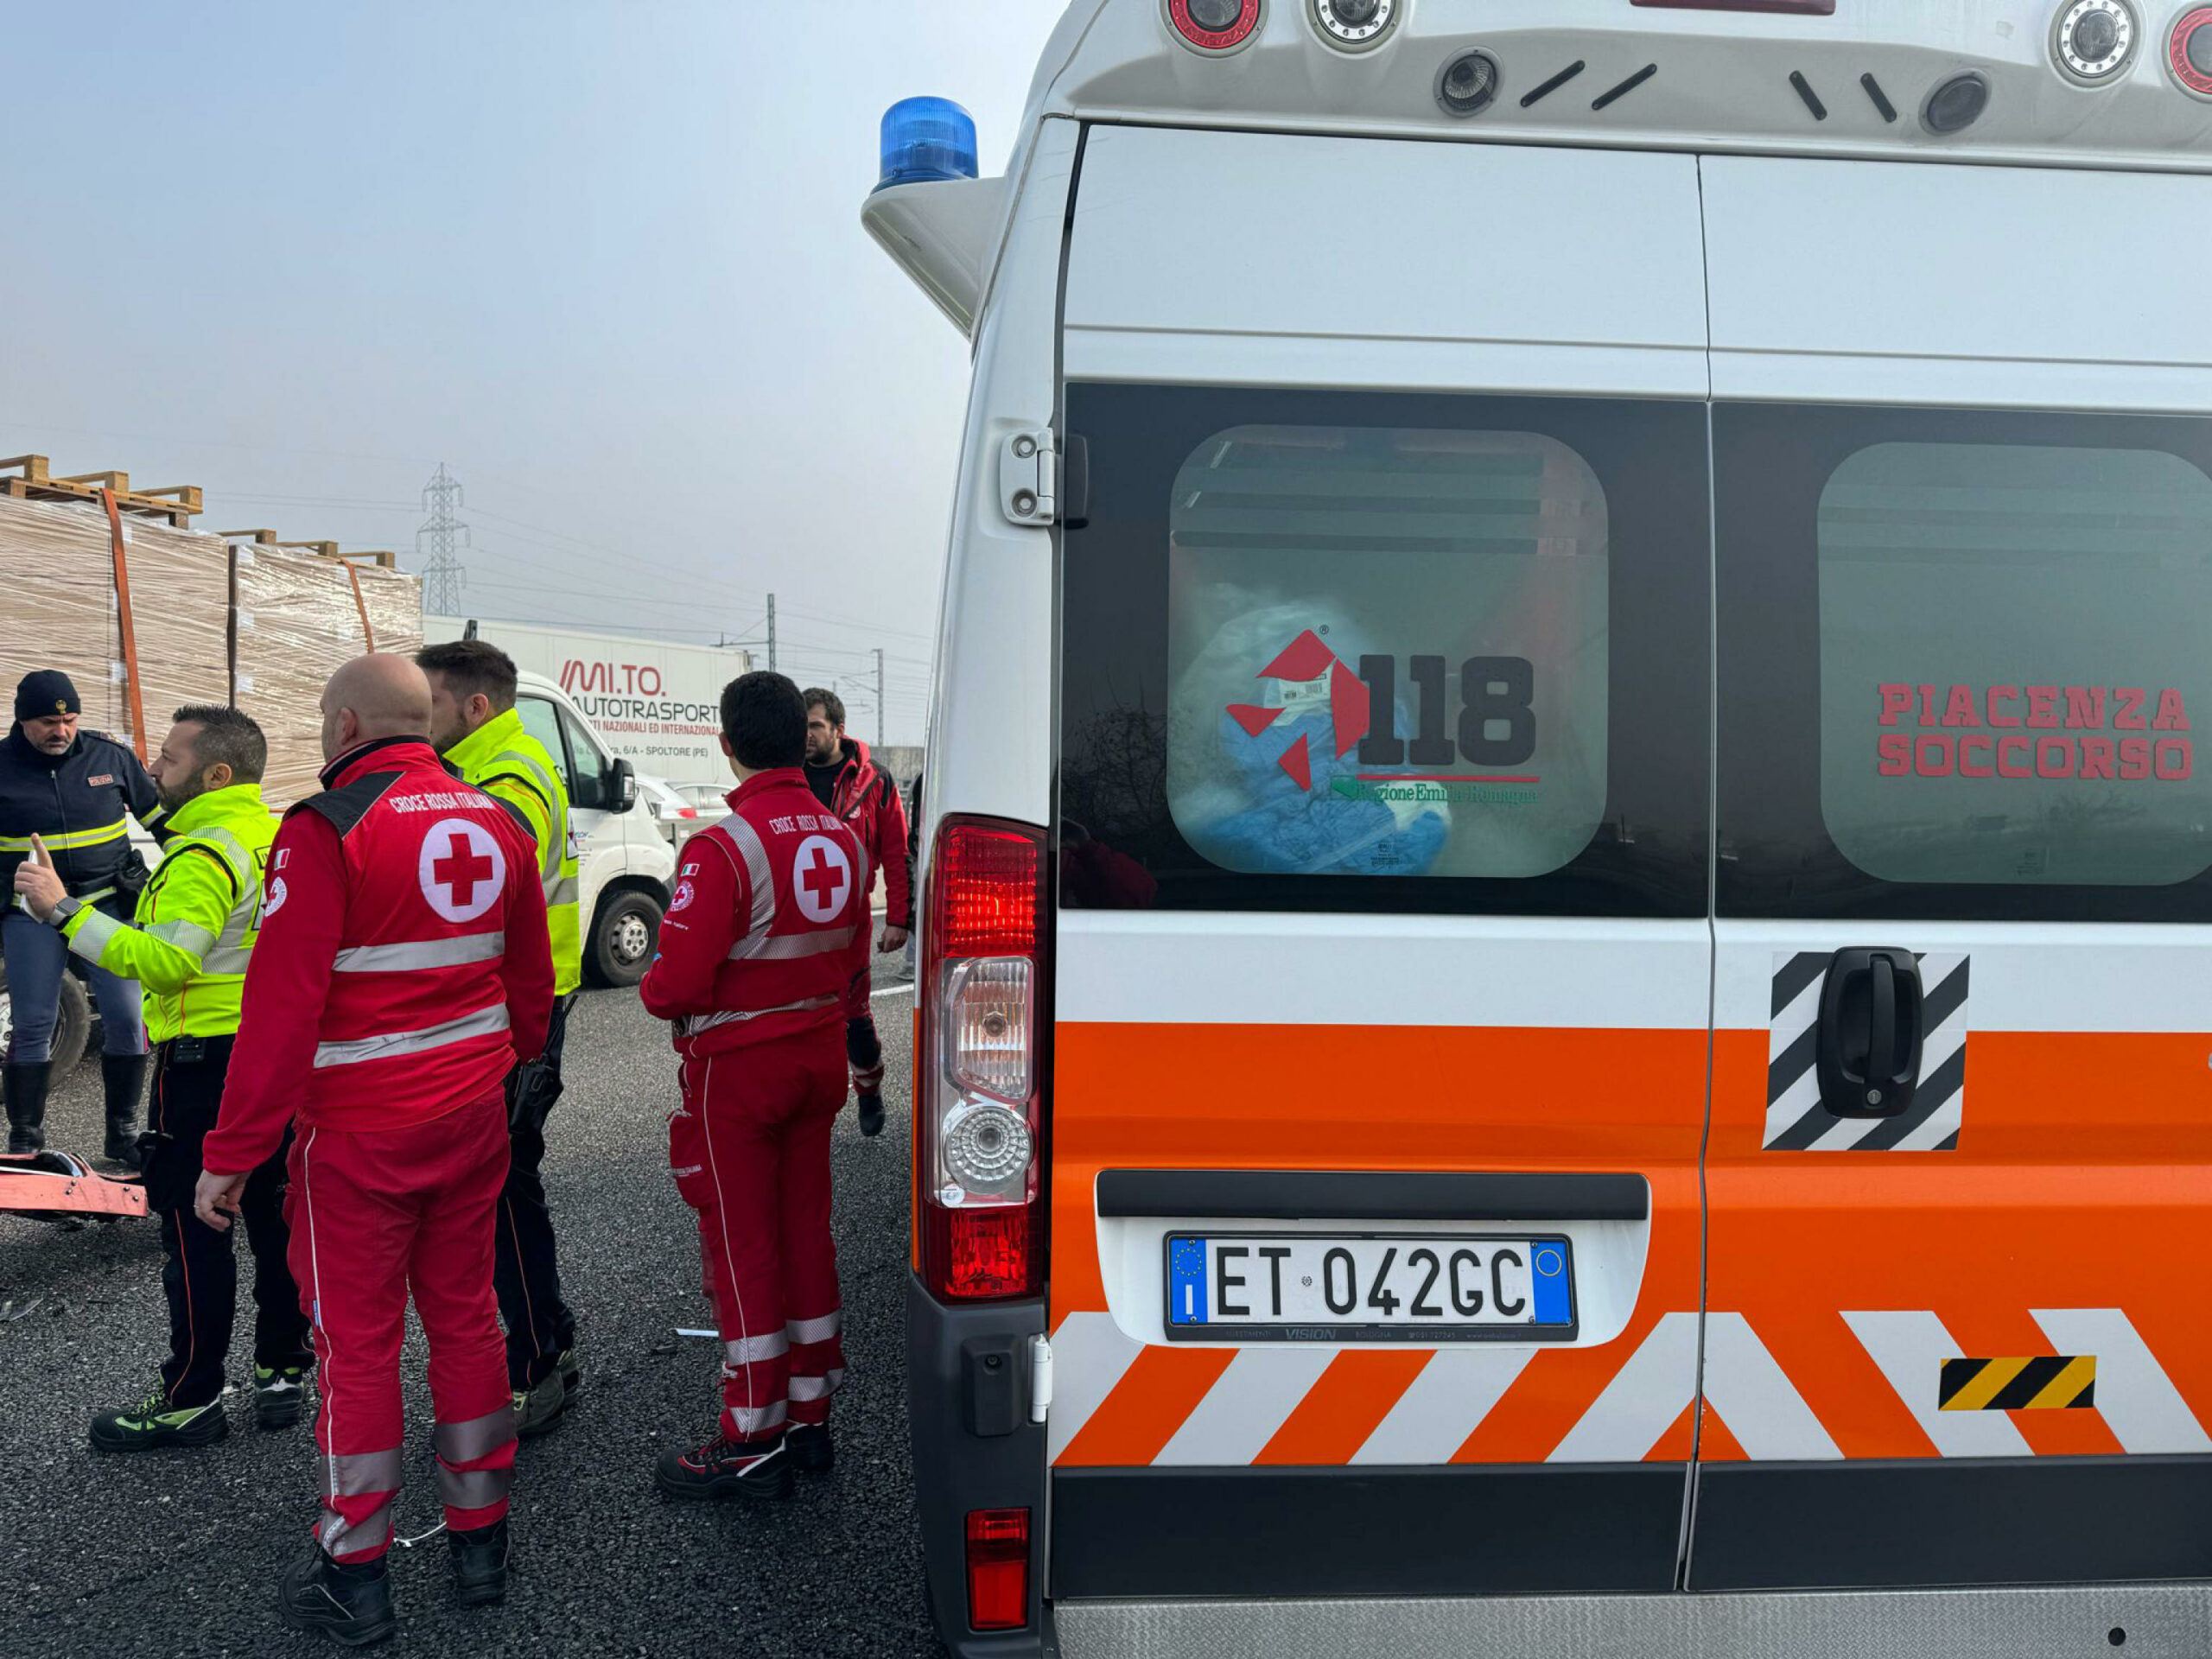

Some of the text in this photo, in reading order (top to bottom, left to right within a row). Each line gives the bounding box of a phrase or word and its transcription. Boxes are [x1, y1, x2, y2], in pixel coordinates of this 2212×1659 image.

[1358, 654, 1536, 766] 118
[1878, 683, 2191, 731] PIACENZA
[603, 720, 647, 734] NAZIONALI
[648, 721, 661, 734] ED
[623, 746, 639, 755] 6/A
[645, 746, 692, 758] SPOLTORE
[692, 747, 709, 760] (PE)
[1878, 733, 2193, 781] SOCCORSO
[389, 795, 429, 813] CROCE
[423, 792, 460, 810] ROSSA
[769, 816, 797, 834] CROCE
[796, 815, 819, 831] ROSSA
[1217, 1247, 1526, 1317] ET 042GC
